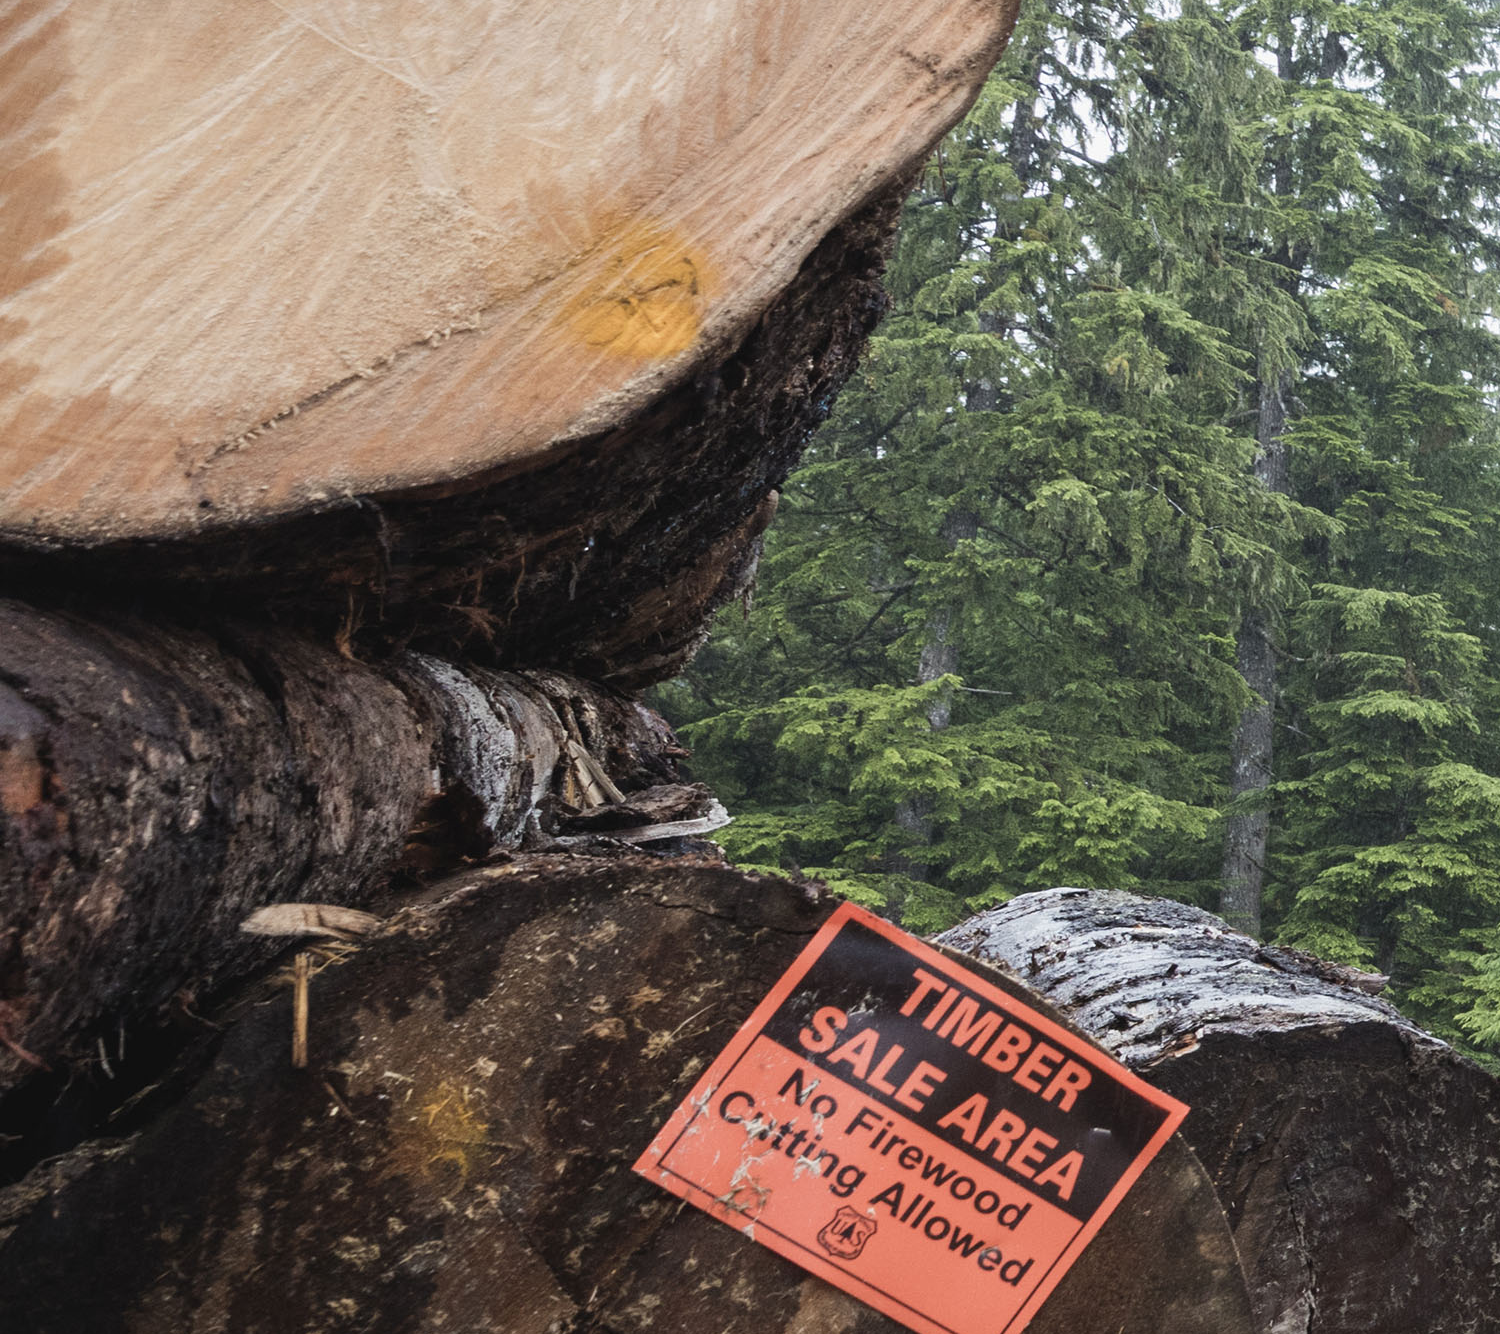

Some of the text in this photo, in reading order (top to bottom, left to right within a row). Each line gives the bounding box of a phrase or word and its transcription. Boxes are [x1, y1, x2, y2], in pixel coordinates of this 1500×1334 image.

[799, 1006, 1086, 1201] SALE AREA
[899, 968, 1093, 1113] TIMBER
[718, 1089, 866, 1198] Cutting
[870, 1179, 1035, 1288] Allowed
[777, 1068, 1032, 1232] No Firewood
